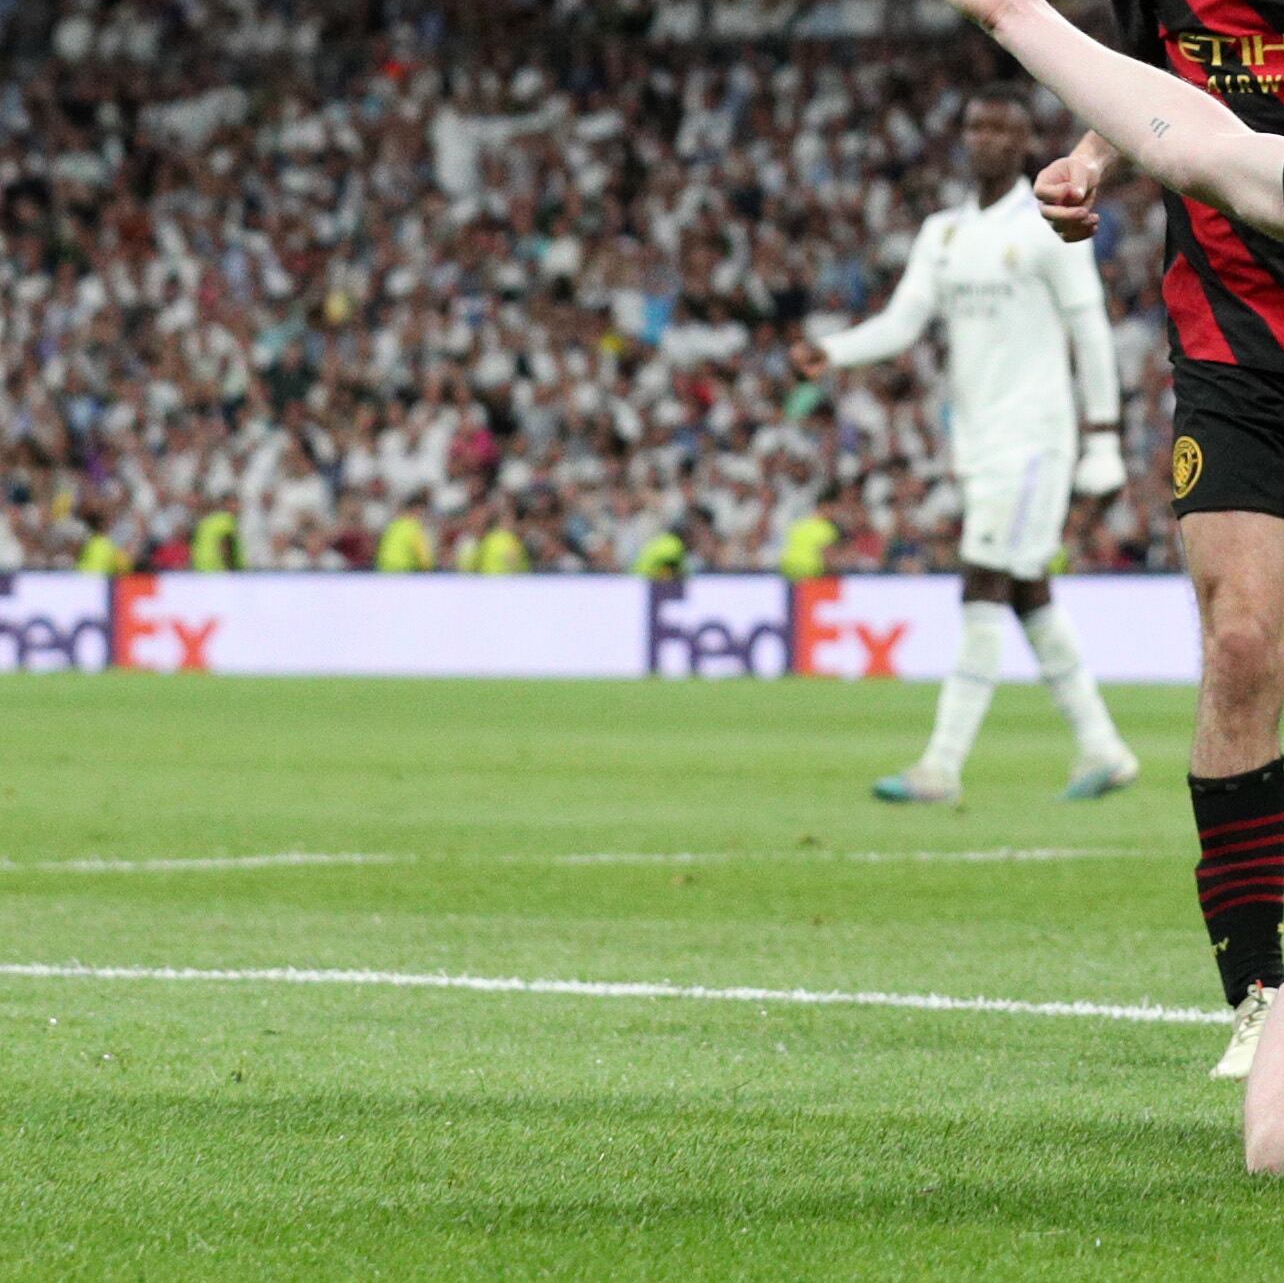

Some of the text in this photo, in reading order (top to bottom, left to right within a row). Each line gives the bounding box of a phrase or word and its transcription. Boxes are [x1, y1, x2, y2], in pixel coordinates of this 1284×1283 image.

[1207, 73, 1284, 95] AIRW
[0, 574, 219, 671] edEx
[649, 575, 909, 677] FedEx
